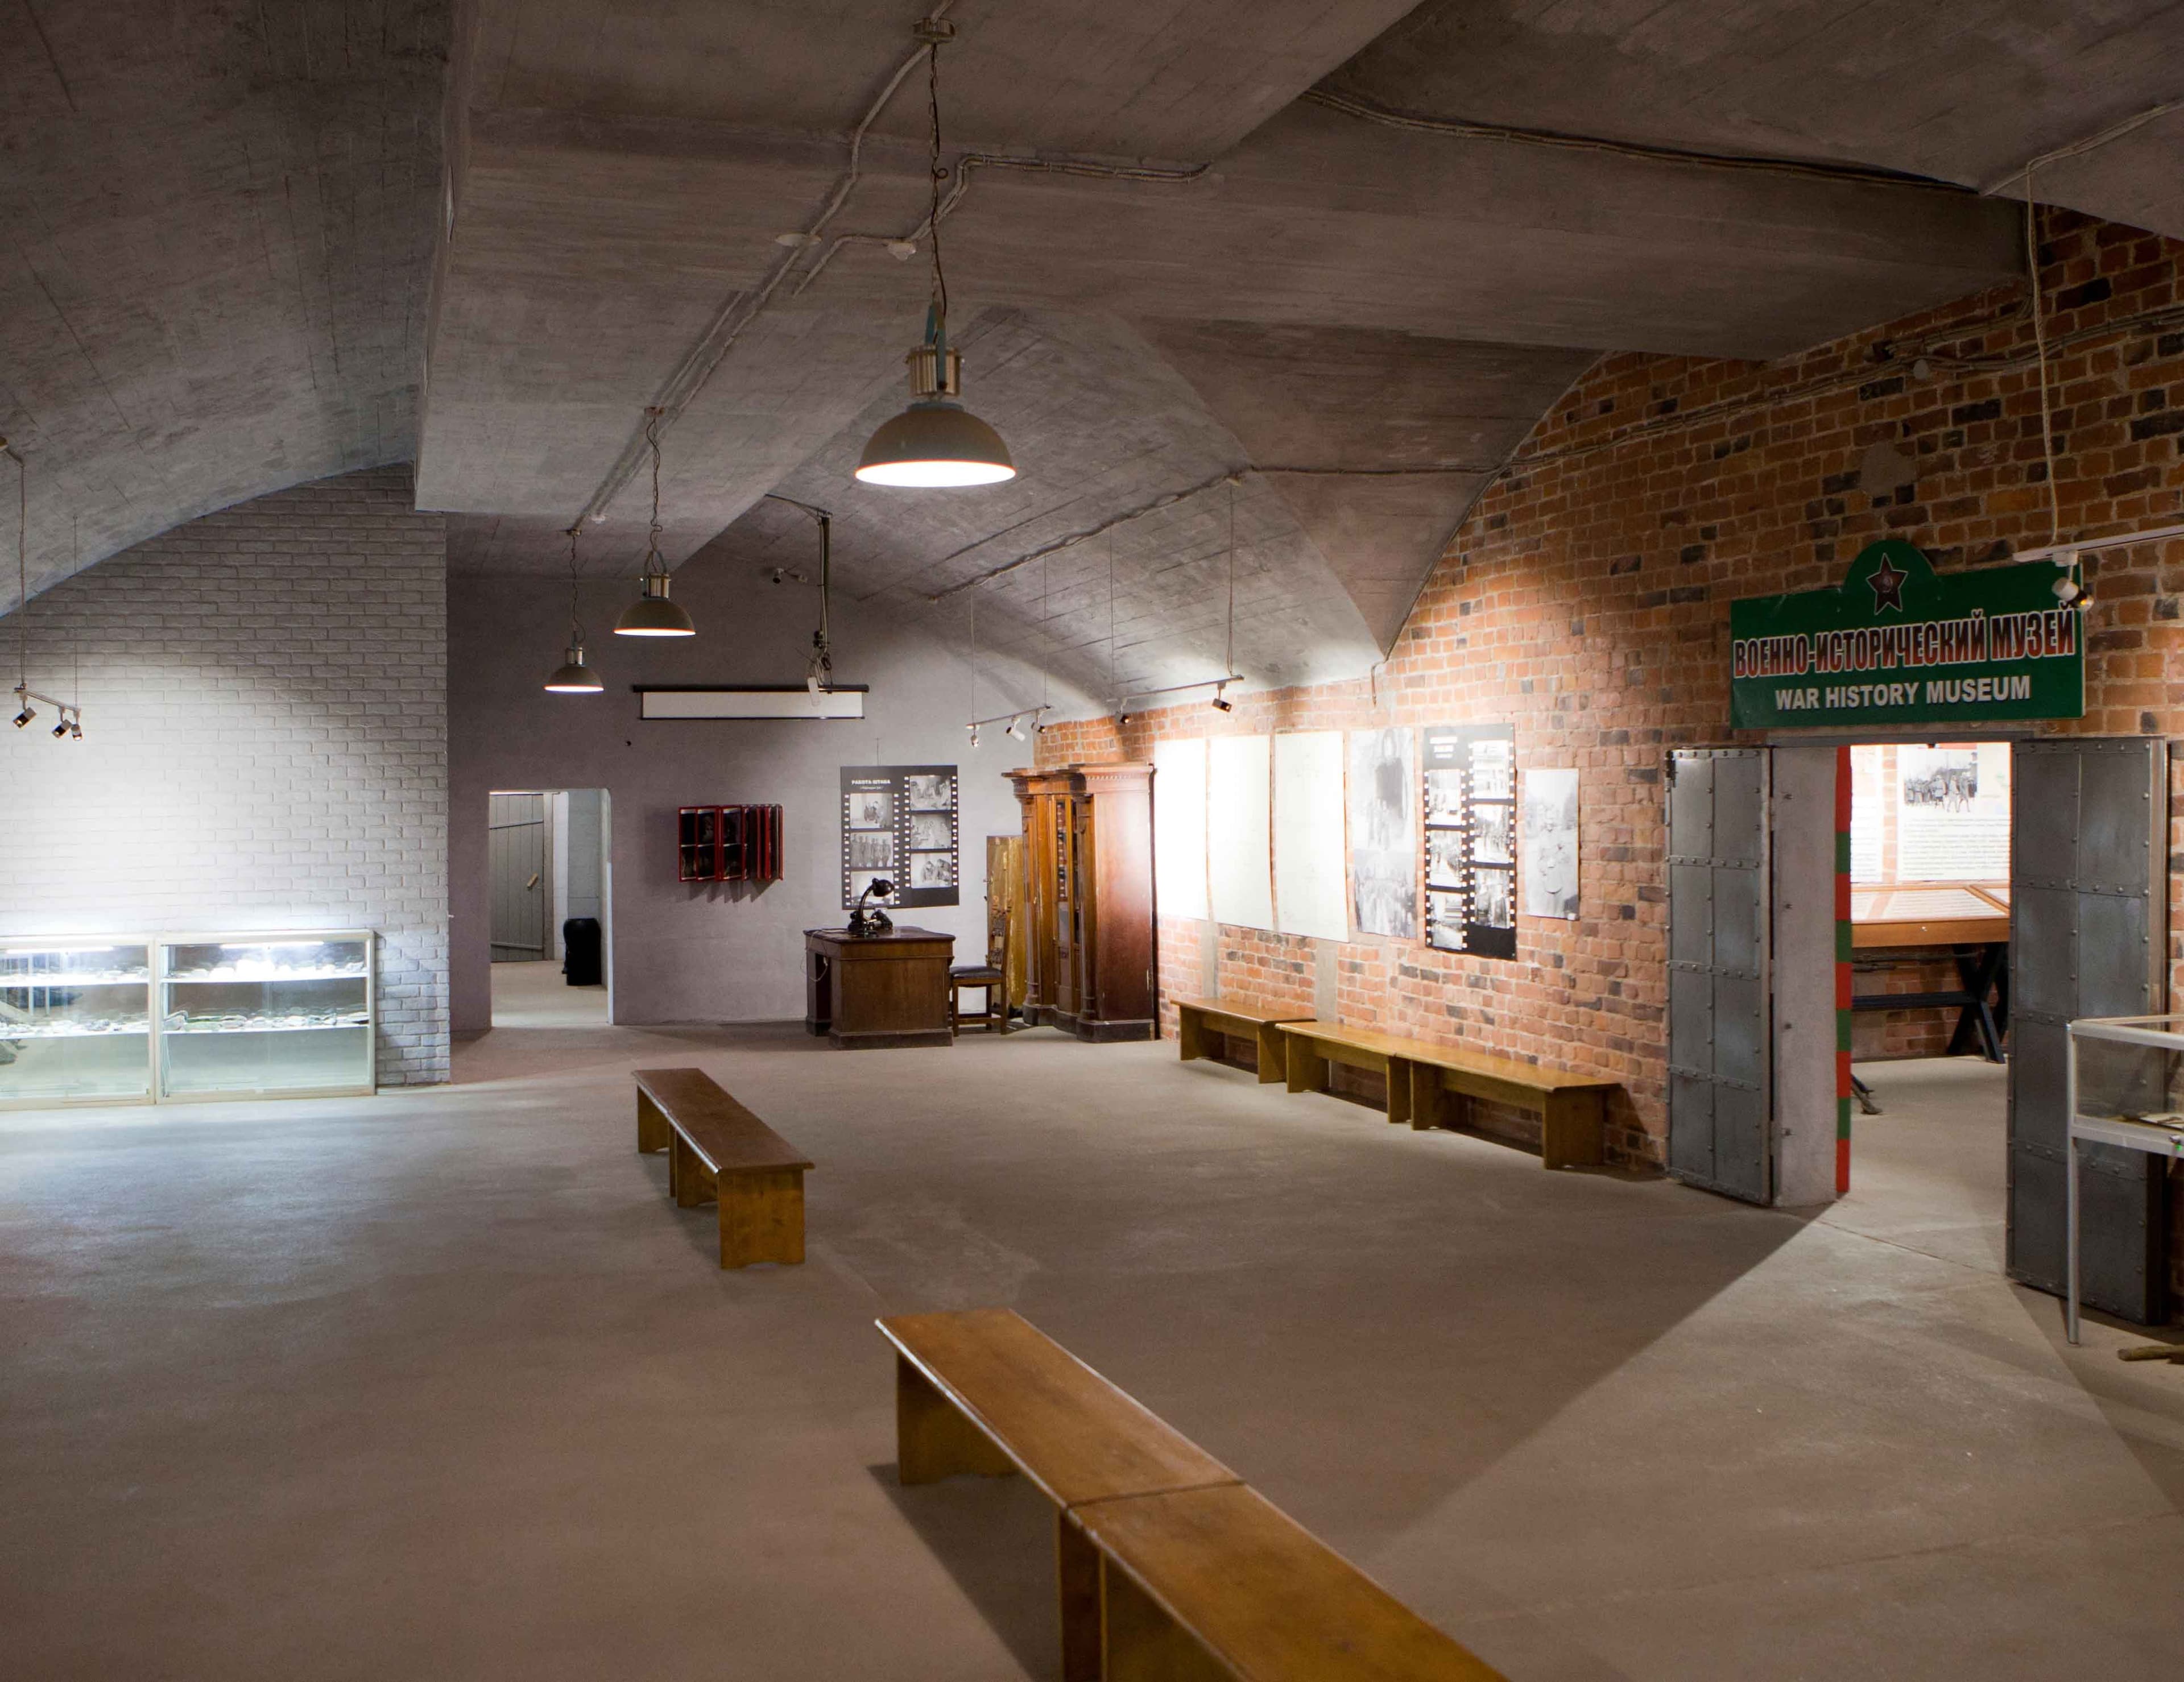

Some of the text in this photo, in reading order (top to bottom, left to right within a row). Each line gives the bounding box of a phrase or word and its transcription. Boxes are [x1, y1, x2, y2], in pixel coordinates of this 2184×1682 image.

[1734, 600, 2075, 678] ВОЕННО-ИСТОРИЧЕСКИЙ МУЗЕЙ
[1775, 676, 2030, 710] WAR HISTORY MUSEUM
